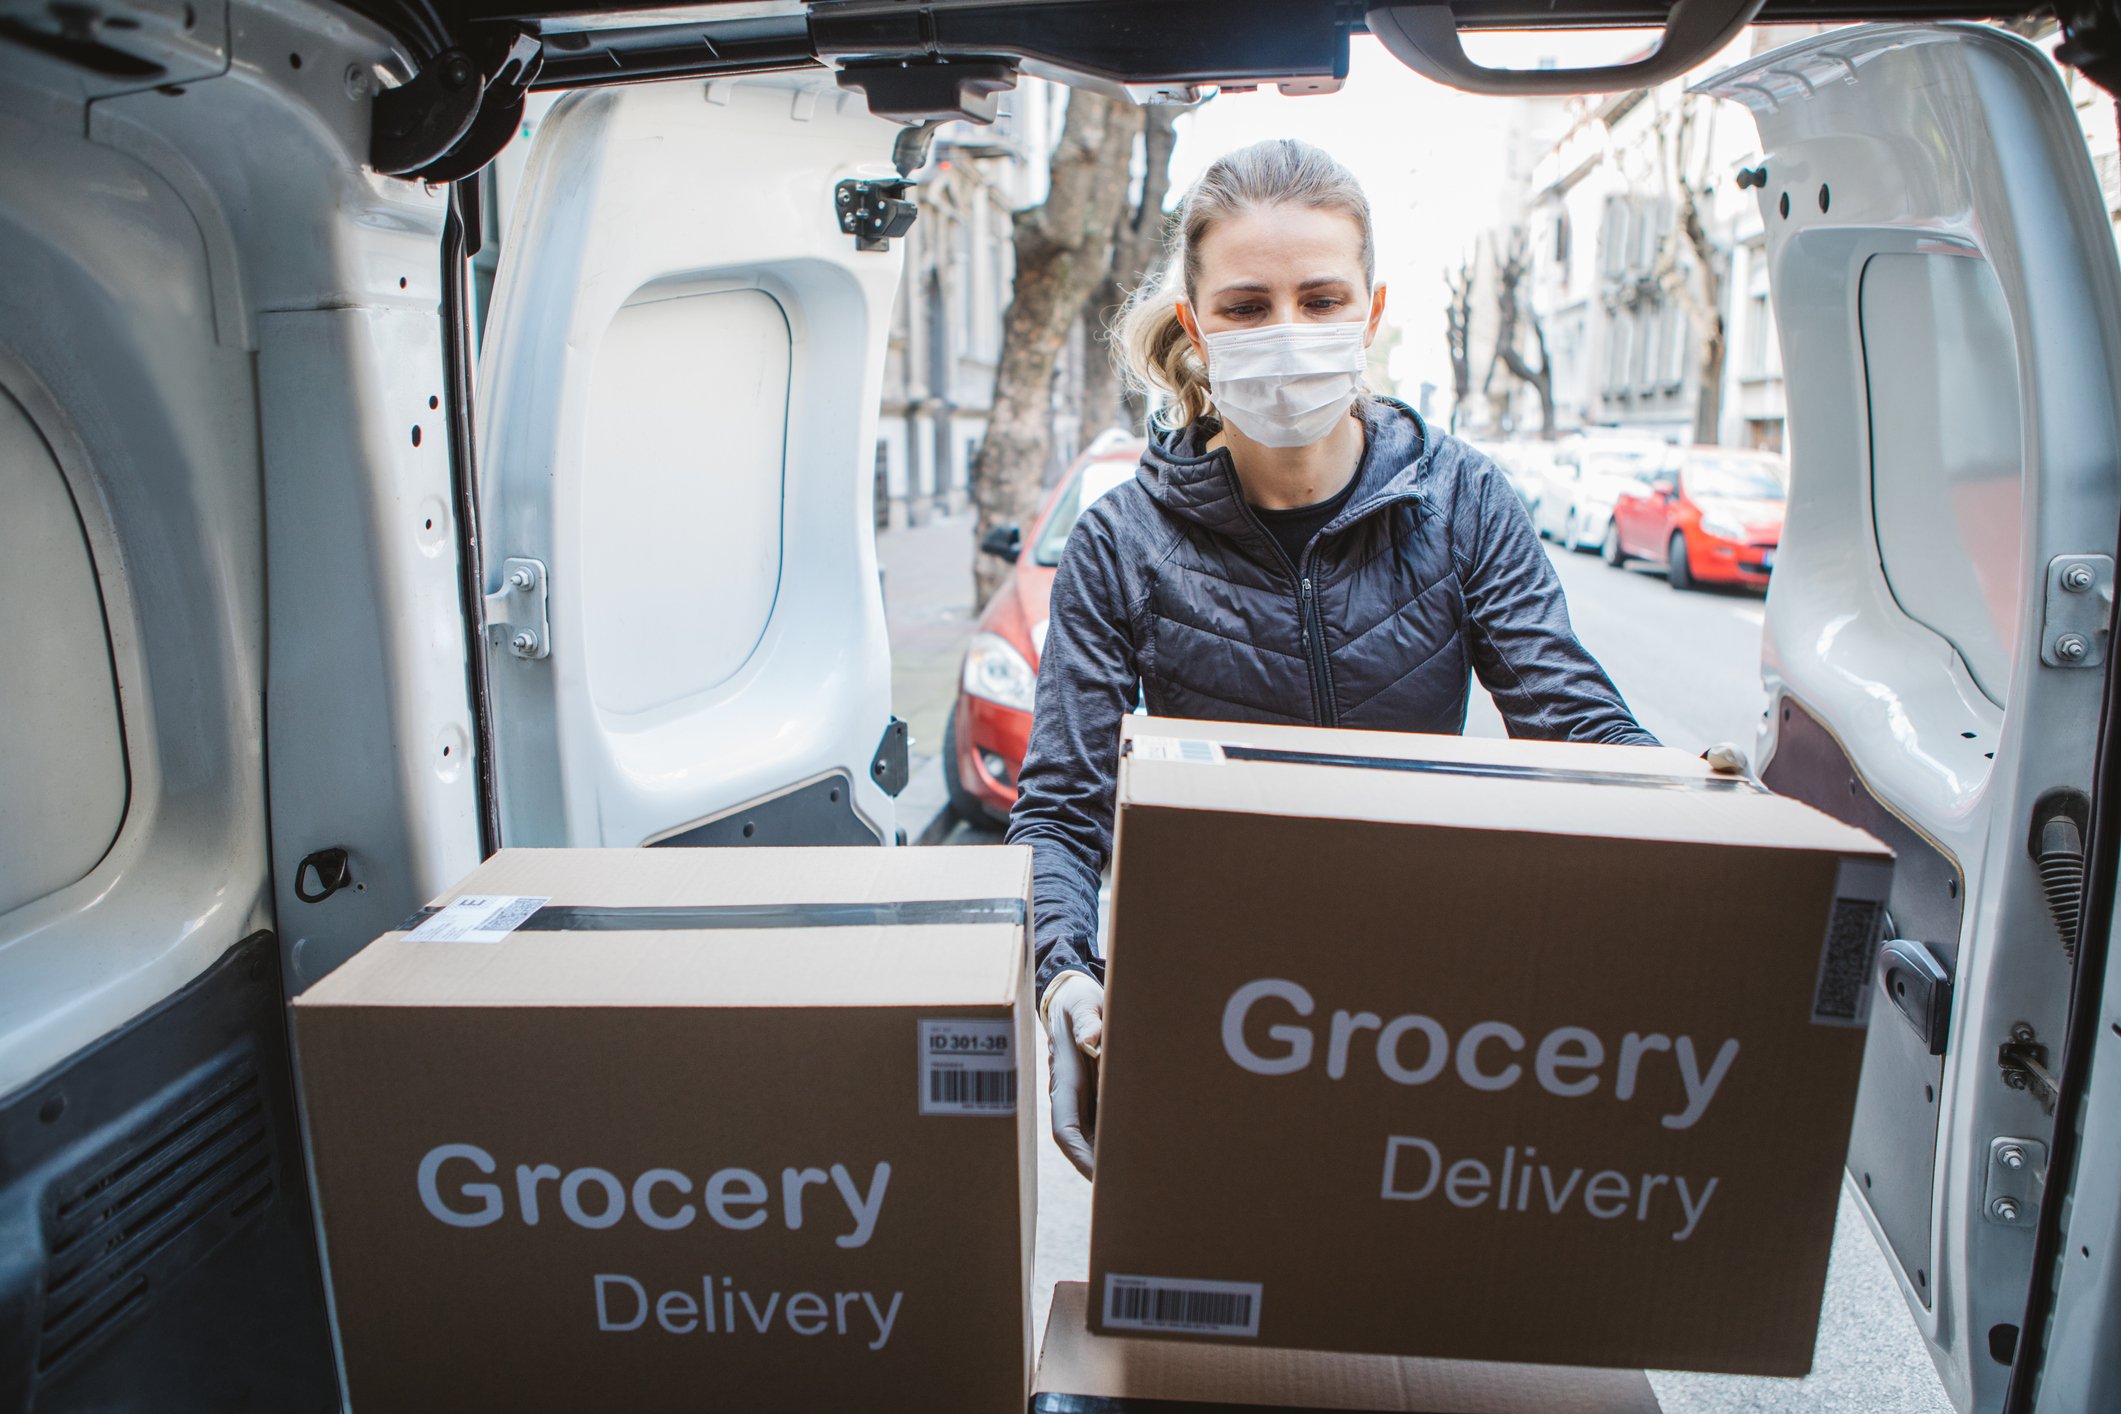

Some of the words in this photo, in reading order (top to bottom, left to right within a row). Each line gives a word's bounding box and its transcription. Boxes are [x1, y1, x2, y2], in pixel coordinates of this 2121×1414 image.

[929, 1034, 947, 1049] ID
[1221, 979, 1739, 1129] Grocery
[417, 1143, 891, 1248] Grocery
[1381, 1136, 1718, 1240] Delivery
[594, 1274, 903, 1350] Delivery
